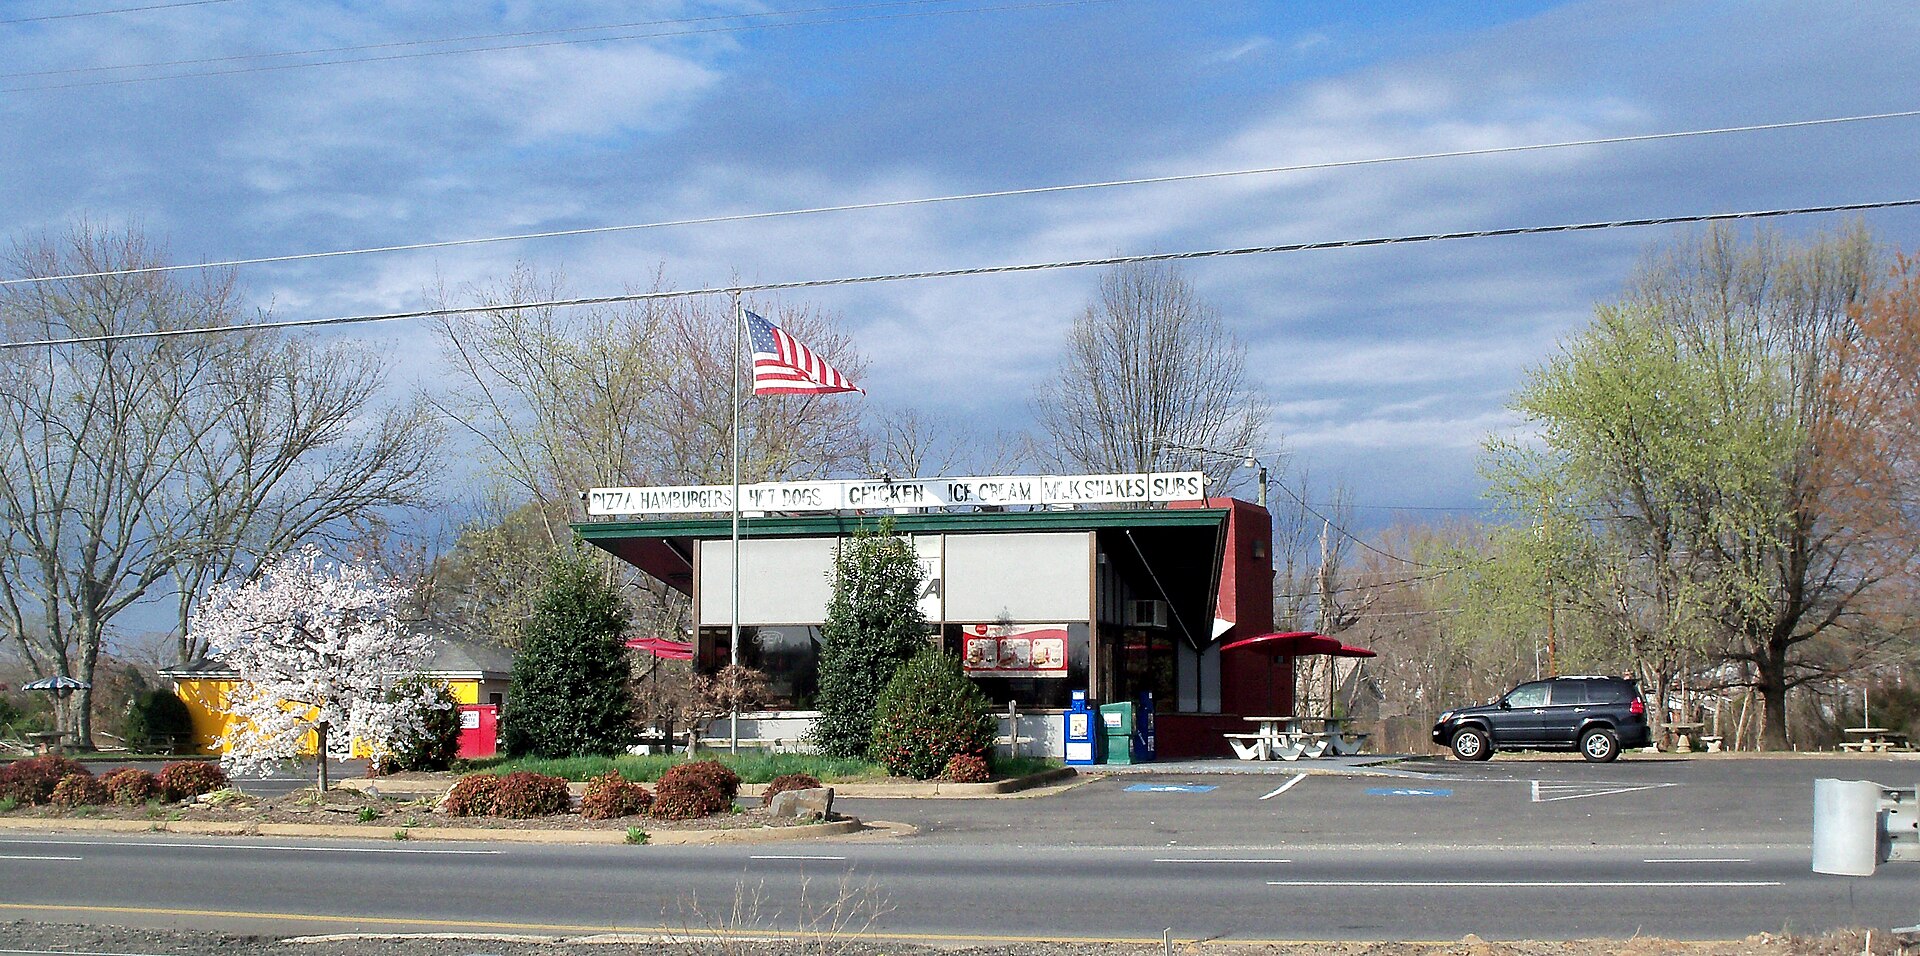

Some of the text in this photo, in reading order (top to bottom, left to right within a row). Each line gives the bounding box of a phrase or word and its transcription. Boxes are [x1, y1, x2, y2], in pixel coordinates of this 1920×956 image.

[782, 487, 823, 507] DOGS
[849, 484, 924, 505] CHICKEN
[948, 481, 1031, 502] ICE CREAM
[1153, 477, 1199, 497] SUBS
[593, 489, 733, 510] PIZZA HAMBURGERS
